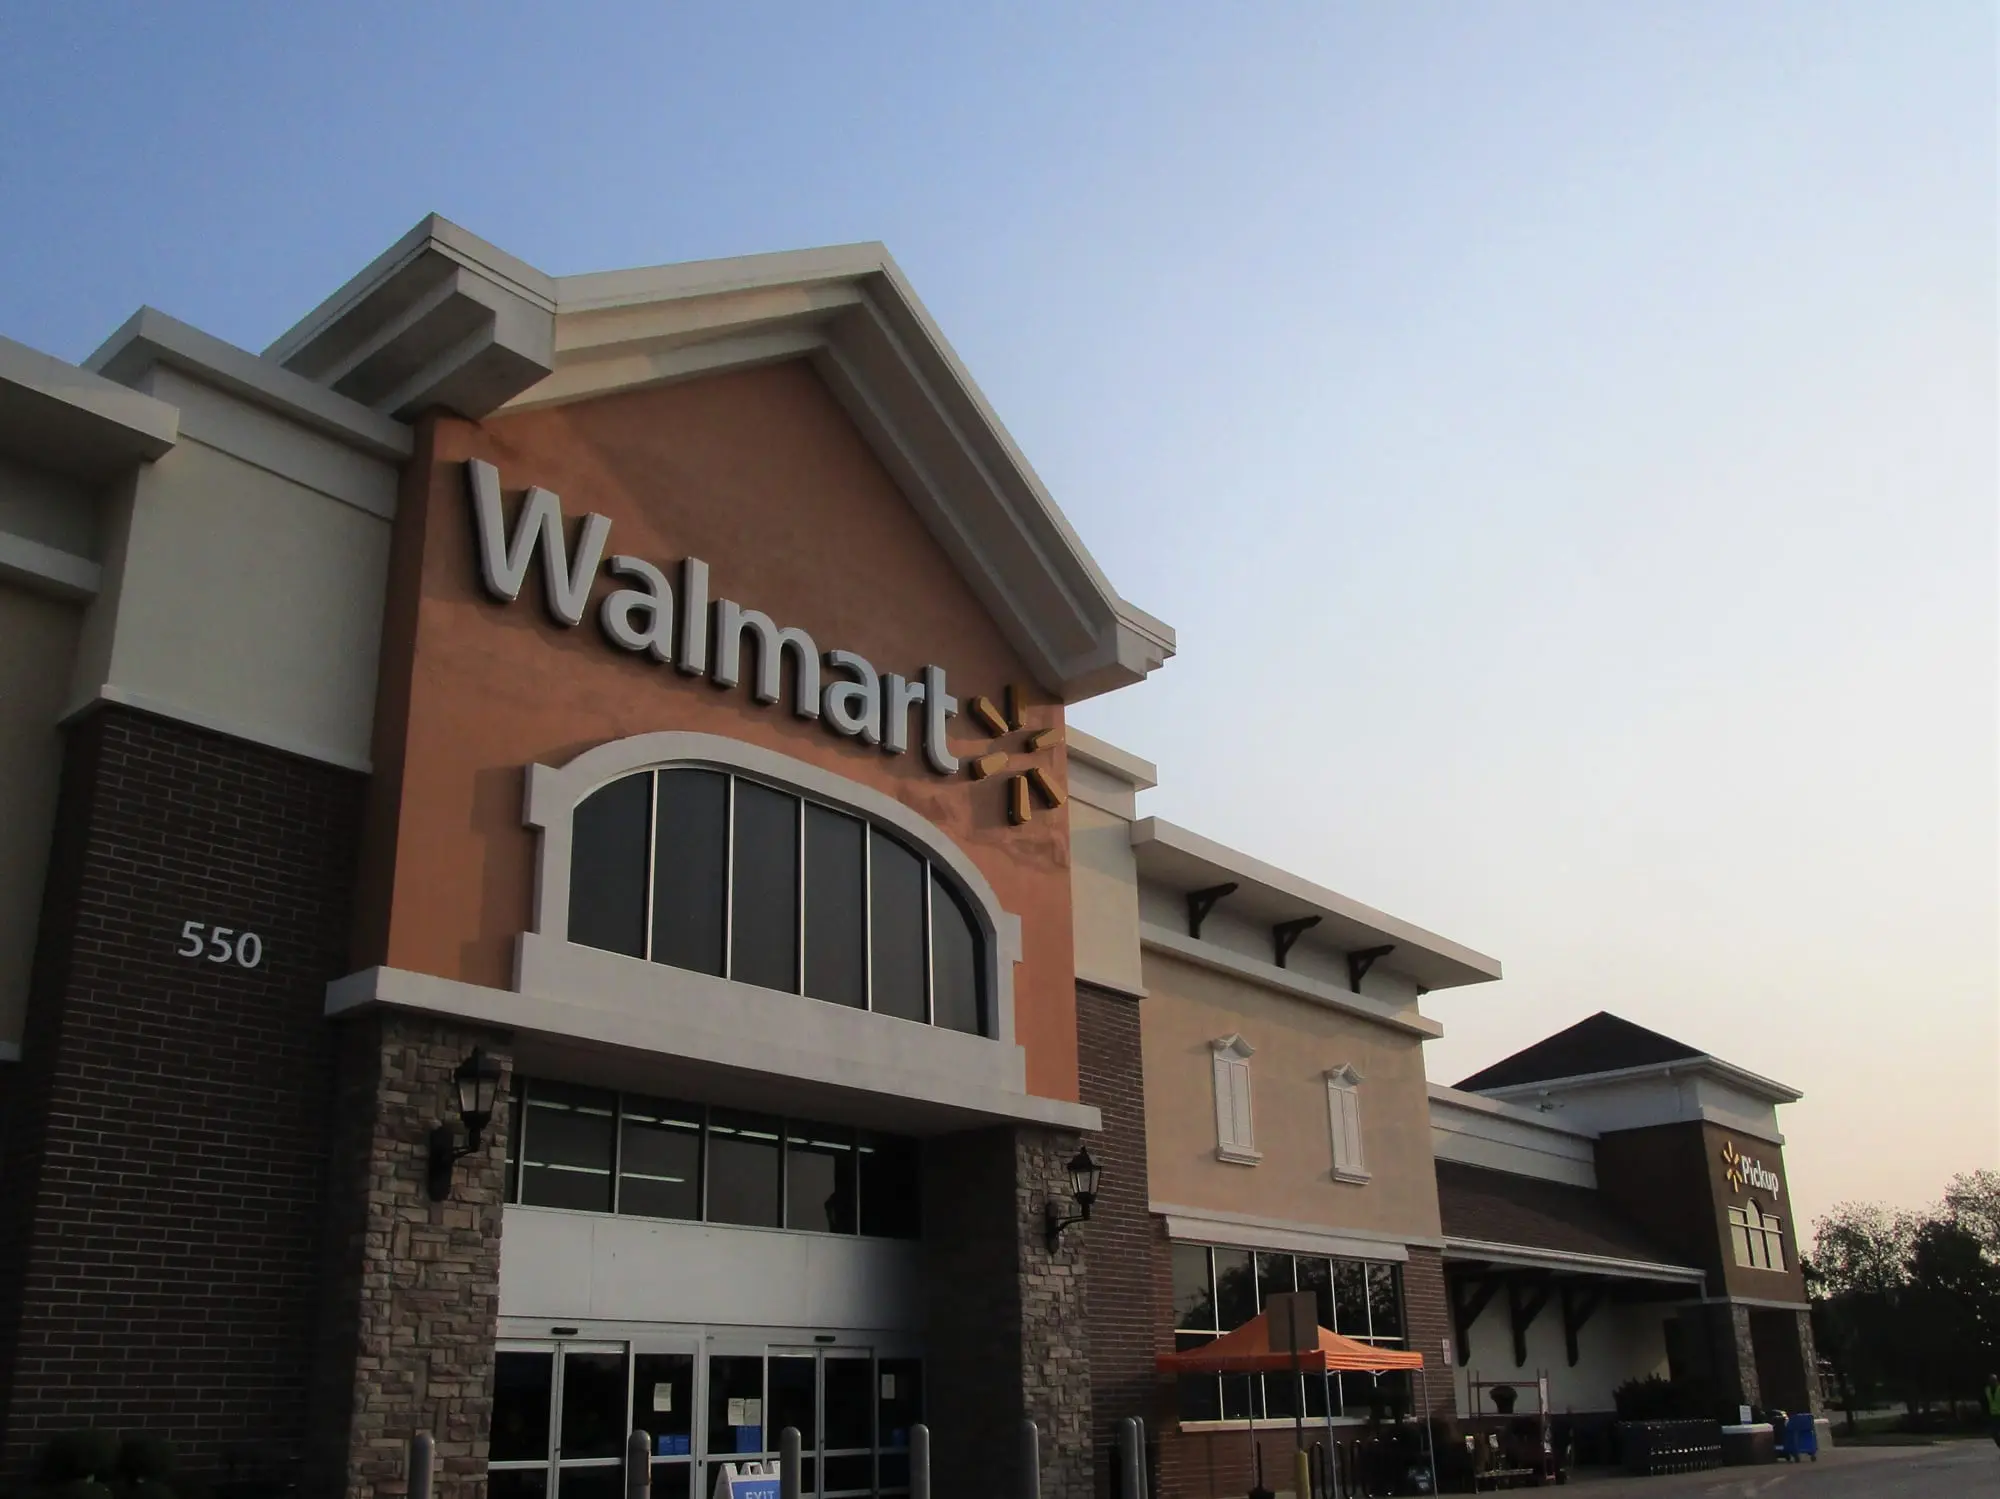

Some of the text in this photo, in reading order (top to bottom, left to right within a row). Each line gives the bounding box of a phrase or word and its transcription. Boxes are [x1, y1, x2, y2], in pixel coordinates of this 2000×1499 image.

[468, 457, 960, 775] Walmart
[178, 920, 262, 968] 550
[1741, 1155, 1779, 1200] Pickup
[745, 1490, 775, 1499] EXIT
